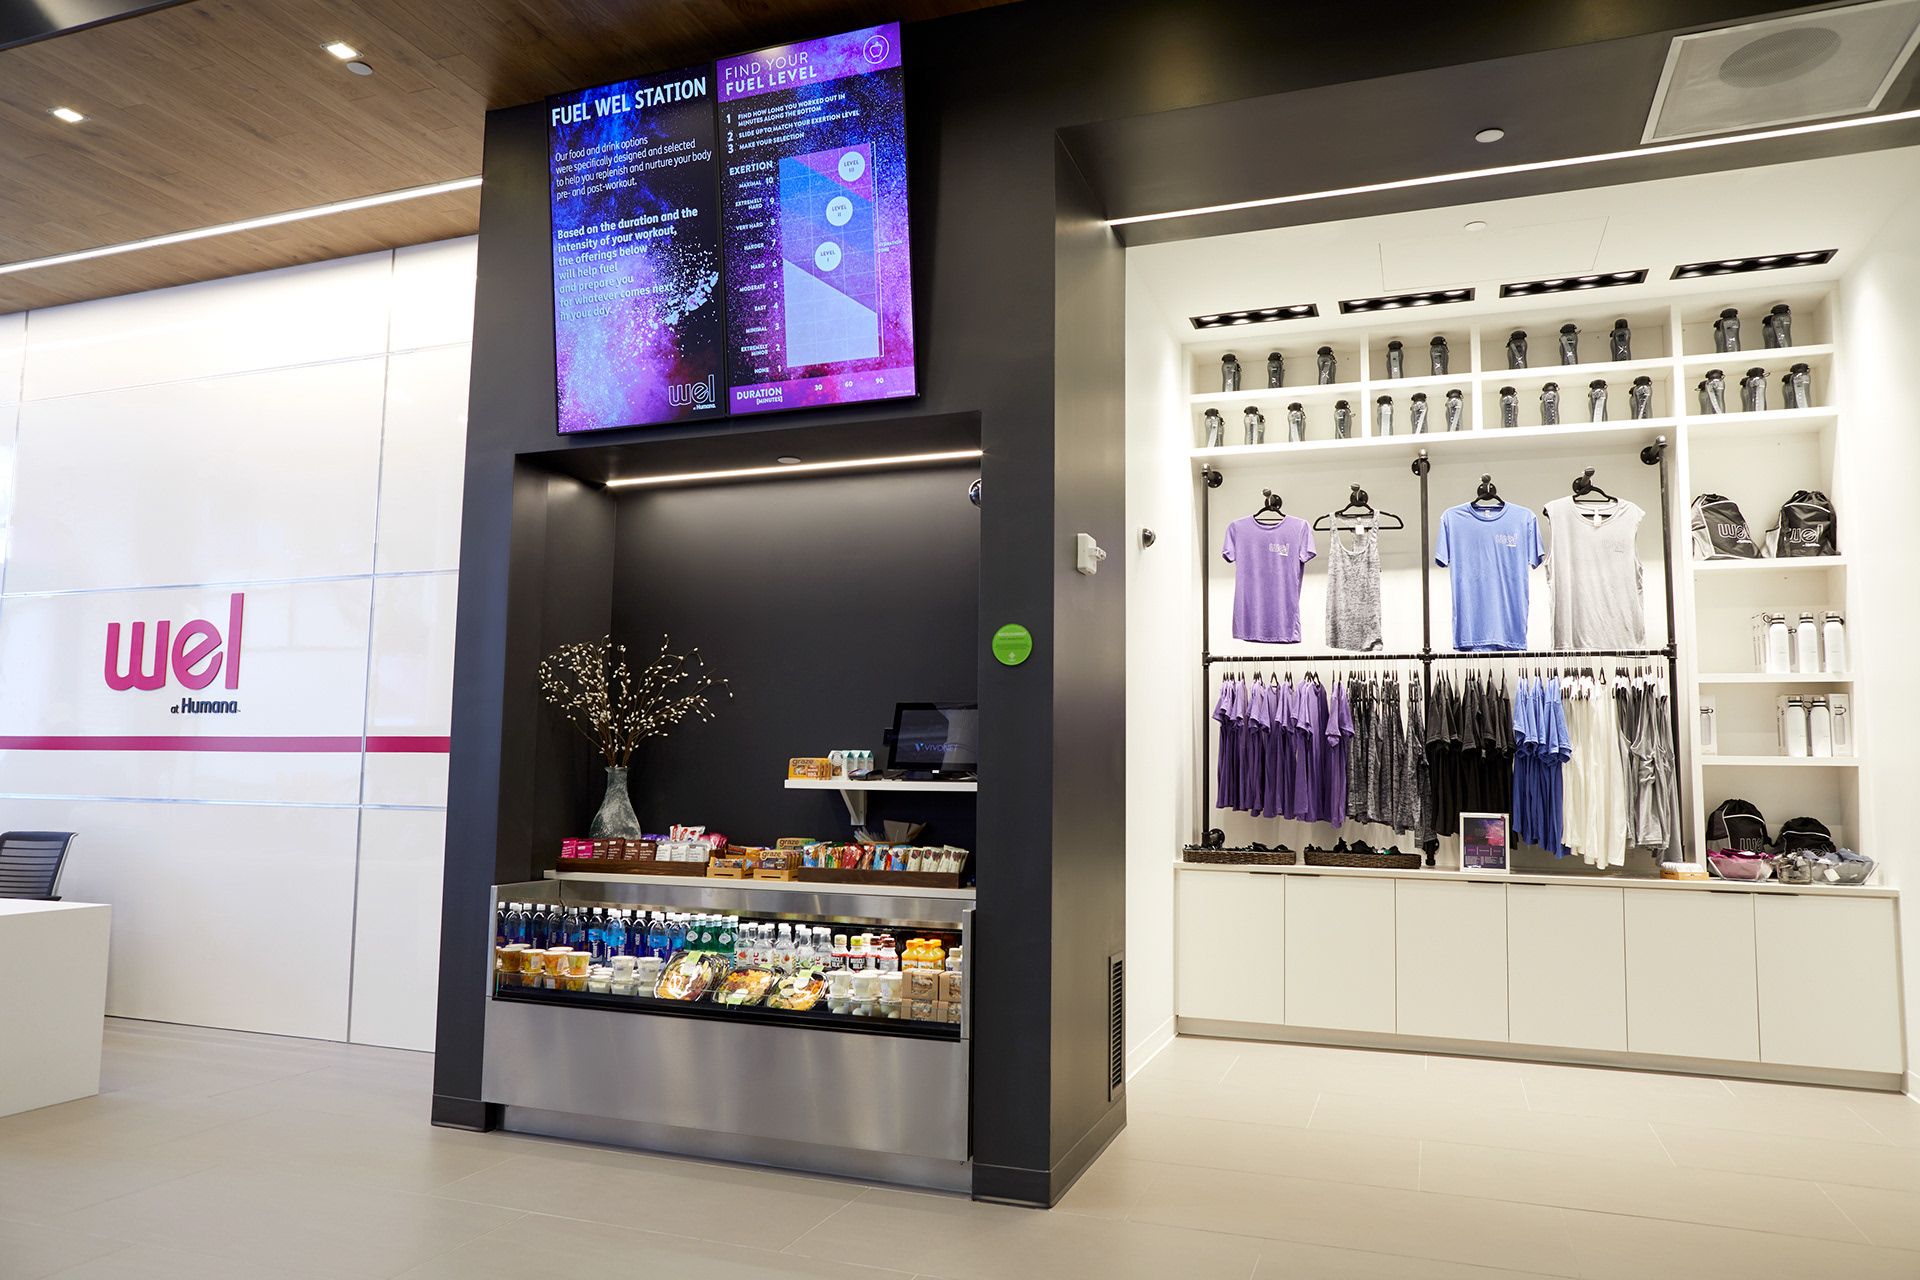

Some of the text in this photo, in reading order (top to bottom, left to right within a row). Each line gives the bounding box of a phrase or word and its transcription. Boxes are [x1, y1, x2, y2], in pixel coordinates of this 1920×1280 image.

[725, 52, 808, 80] FIND YOUR
[726, 66, 817, 96] FUEL LEVEL
[552, 77, 706, 126] FUEL WEL STATION
[726, 114, 731, 124] 1
[768, 106, 784, 114] LONG
[798, 98, 824, 108] WORKED
[728, 132, 734, 142] 2
[739, 130, 754, 138] SLIDE
[772, 122, 793, 132] MATCH
[794, 118, 810, 127] YOUR
[811, 114, 840, 124] EXERTION
[842, 110, 860, 119] LEVEL
[738, 118, 763, 126] MINUTES
[764, 114, 784, 122] ALONG
[797, 106, 821, 116] BOTTOM
[556, 136, 648, 162] Our food and drink options
[728, 132, 804, 154] 3 MAKE YOUR SELECTION
[556, 138, 696, 174] were specifically designed and selected
[556, 150, 712, 189] to help you replenish and nurture your body
[730, 160, 772, 176] EXERTION
[556, 178, 638, 202] pre- and post-workout.
[766, 177, 774, 185] 10
[736, 198, 762, 207] EXTREMELY
[558, 207, 698, 240] Based on the duration and the
[558, 225, 677, 253] intensity of your workout,
[558, 244, 648, 267] the offerings below
[558, 262, 618, 281] will help fuel
[559, 276, 634, 295] and prepare you
[740, 284, 766, 292] MODERATE
[559, 296, 572, 308] for
[574, 290, 618, 306] whatever
[620, 287, 650, 299] comes
[560, 310, 568, 321] in
[570, 308, 592, 323] your
[741, 344, 768, 352] EXTREMELY
[668, 374, 715, 406] wel
[736, 387, 782, 400] DURATION
[1268, 543, 1290, 553] wel
[104, 592, 244, 692] wel
[170, 704, 180, 714] at
[792, 759, 814, 767] graze
[762, 851, 782, 859] graze
